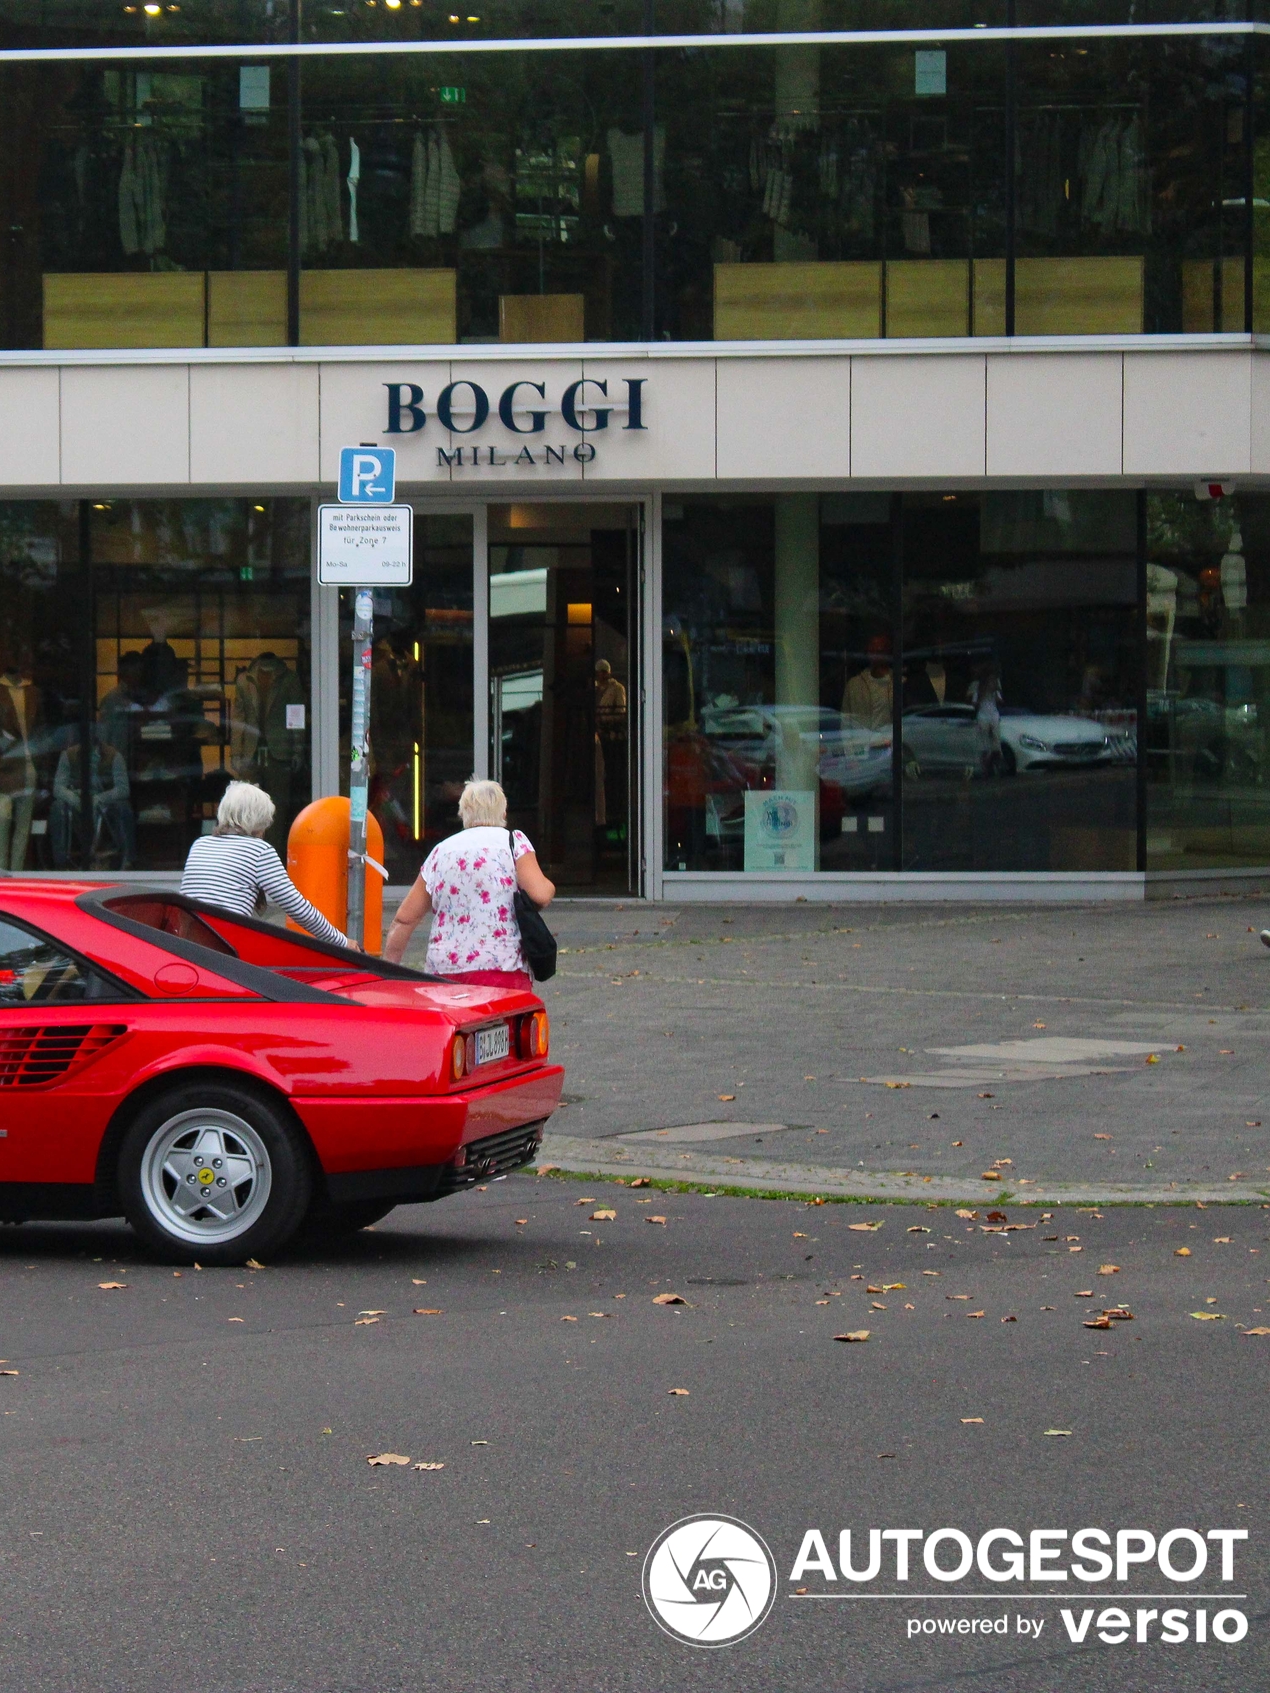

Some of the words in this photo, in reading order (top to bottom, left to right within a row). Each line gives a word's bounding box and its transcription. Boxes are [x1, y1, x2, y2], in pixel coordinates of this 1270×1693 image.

[382, 379, 648, 433] BOGGI
[436, 442, 596, 466] MILANO
[352, 455, 381, 496] P
[332, 513, 343, 522] mit
[346, 513, 381, 522] Parkschein
[383, 513, 397, 522] oder
[329, 523, 401, 533] Bewohnerparkausweis
[343, 536, 355, 544] für
[359, 536, 379, 544] Zone
[382, 536, 387, 544] 7
